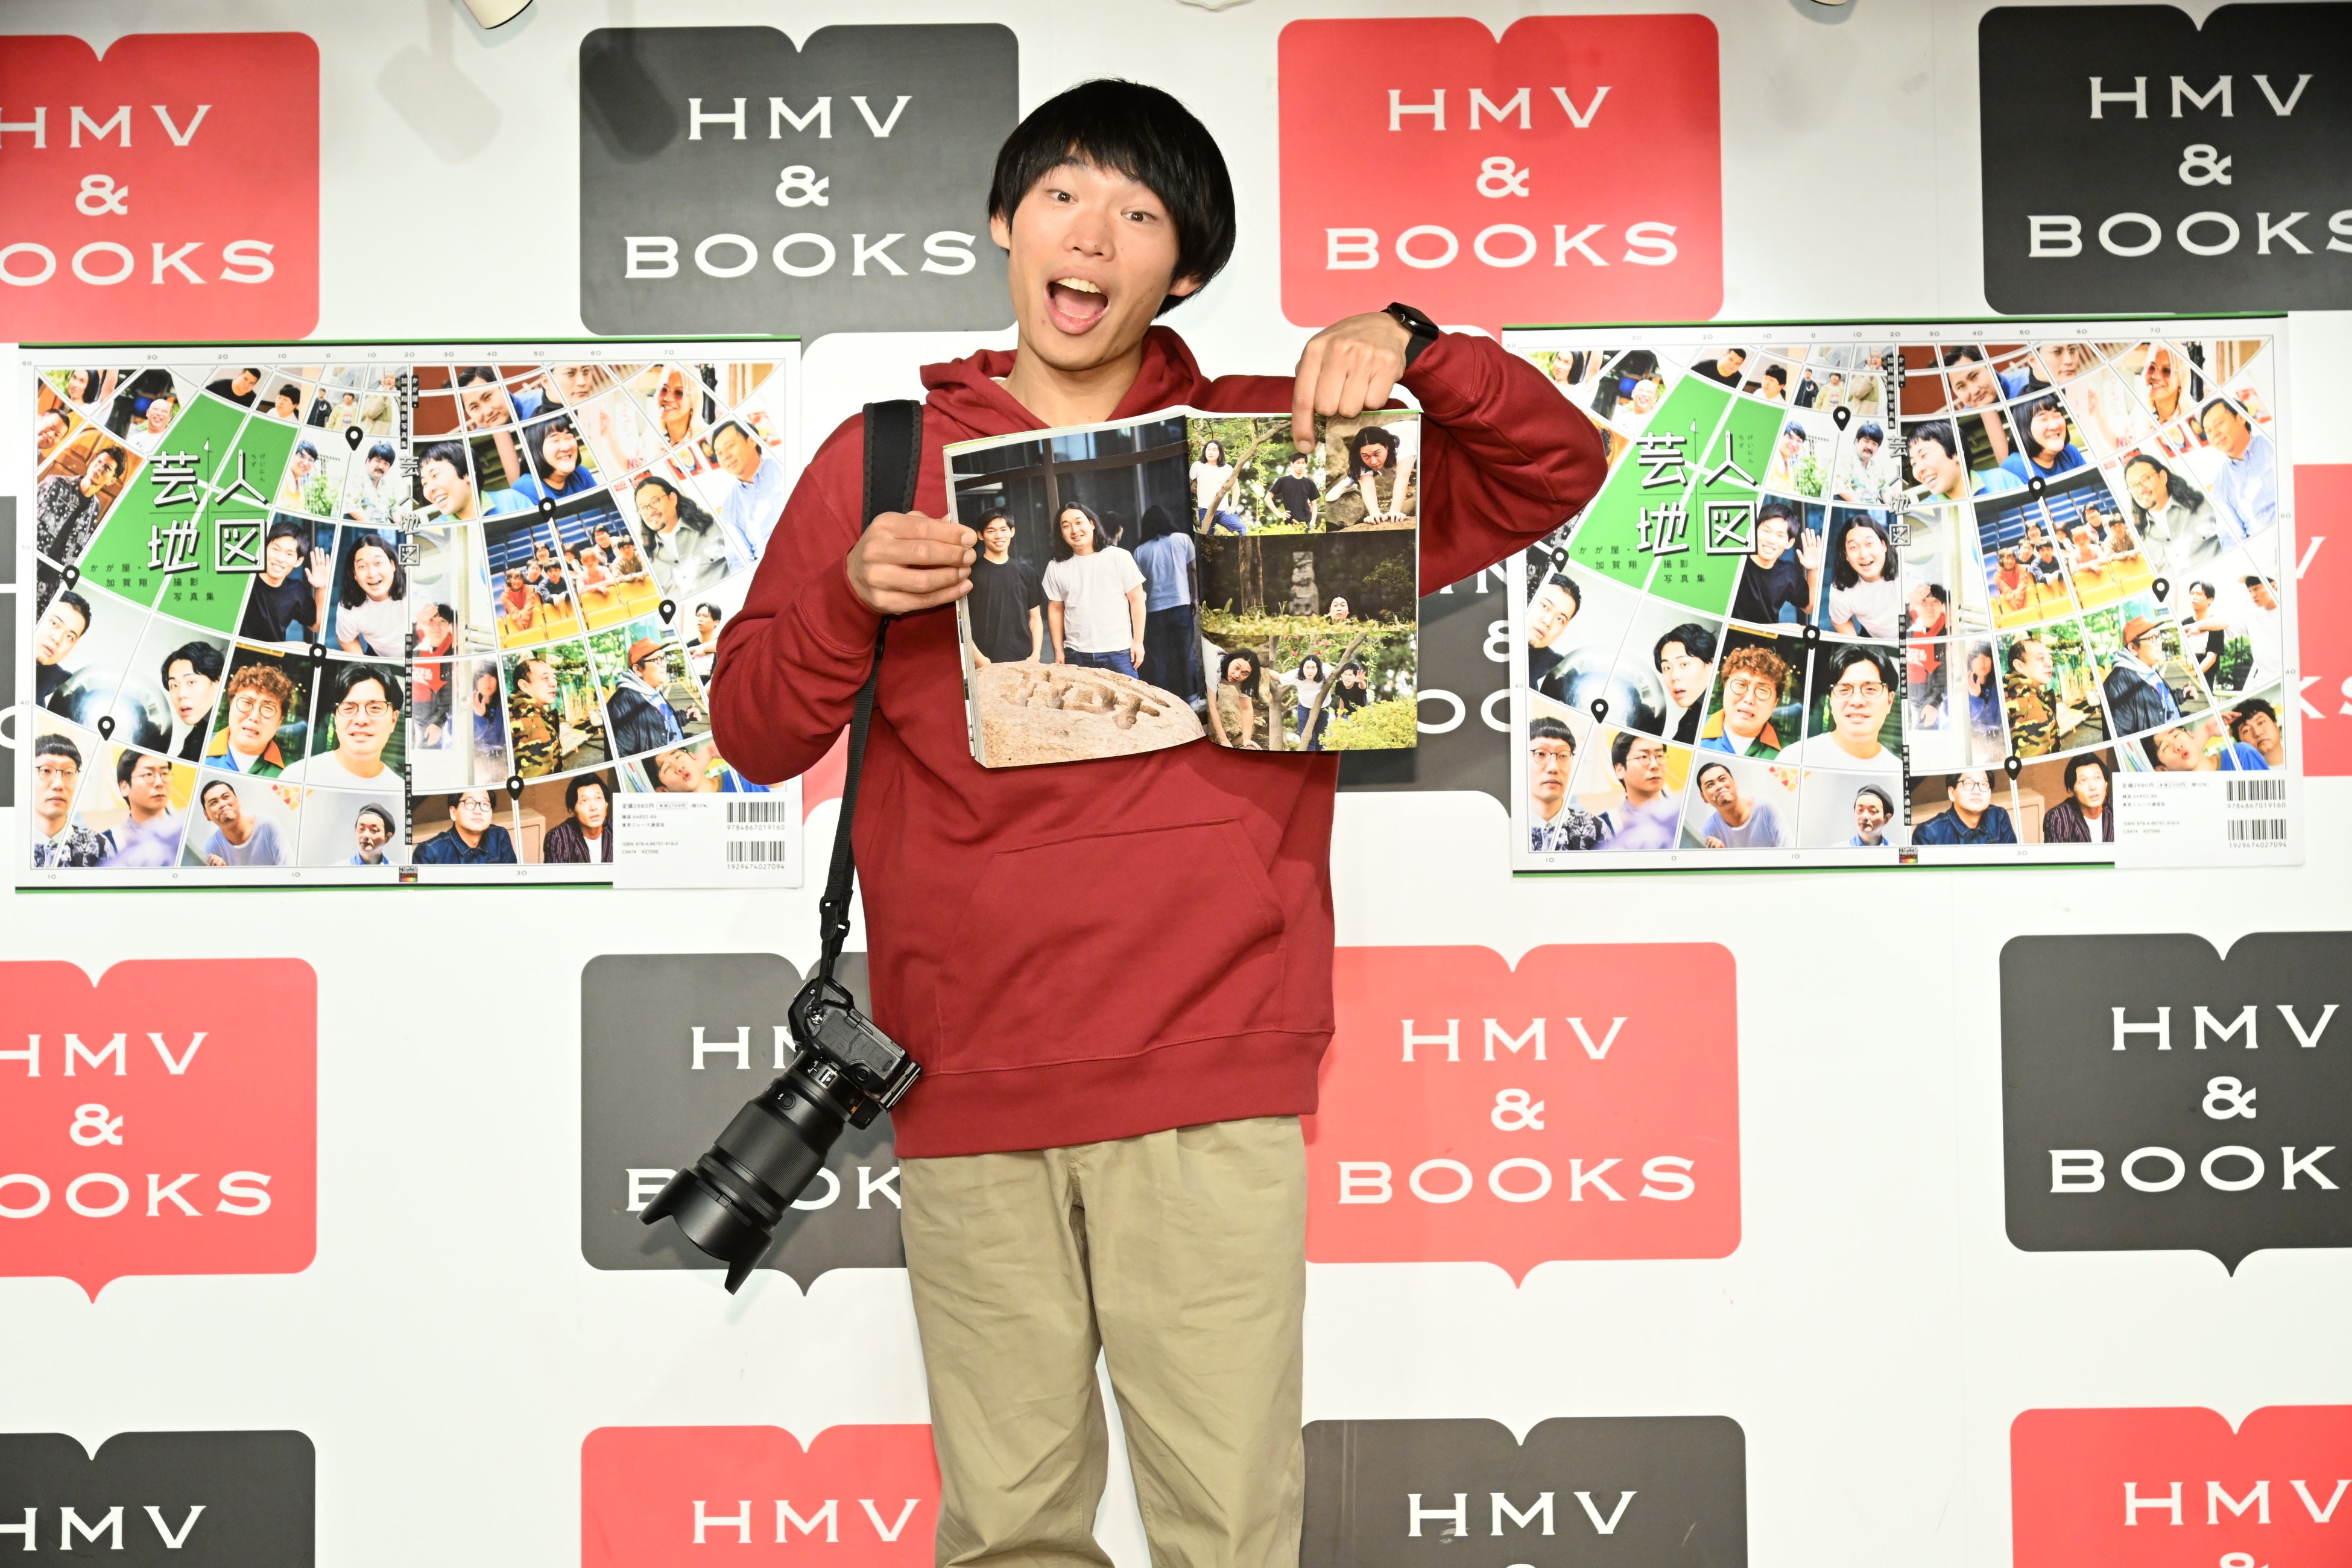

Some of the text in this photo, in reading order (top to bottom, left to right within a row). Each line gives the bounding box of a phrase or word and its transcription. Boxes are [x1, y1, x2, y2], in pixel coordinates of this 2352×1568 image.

[689, 96, 912, 139] HMV
[1388, 87, 1610, 130] HMV
[2090, 75, 2311, 118] HMV
[0, 105, 210, 148] HMV
[776, 166, 829, 207] &
[1477, 157, 1529, 198] &
[2179, 144, 2231, 186] &
[76, 175, 128, 215] &
[0, 240, 274, 286] OOKS
[625, 231, 976, 277] BOOKS
[1326, 222, 1677, 269] BOOKS
[147, 449, 268, 507] 芸人
[1634, 430, 1757, 489] 芸人
[398, 456, 420, 565] 芸人地図
[1888, 435, 1911, 546] 芸人地図
[147, 519, 267, 575] 地図
[1636, 500, 1759, 557] 地図
[106, 577, 198, 587] 加賀翔 撮影
[1595, 559, 1689, 569] 加賀翔 撮影
[1664, 574, 1706, 583] 写真集
[174, 592, 215, 601] 写真集
[1903, 747, 1911, 824] 東京ニュース通信社
[1402, 1017, 1627, 1061] HMV
[2112, 1005, 2339, 1050] HMV
[0, 1032, 207, 1076] HMV
[1491, 1089, 1544, 1131] &
[2202, 1076, 2256, 1119] &
[70, 1104, 122, 1146] &
[625, 1166, 901, 1212] BOK
[1338, 1156, 1694, 1203] BOOKS
[2049, 1146, 2339, 1192] BOOK
[0, 1171, 271, 1218] OOKS
[693, 1499, 920, 1543] HMV
[1408, 1491, 1637, 1536] HMV
[2124, 1480, 2351, 1525] HMV
[0, 1506, 206, 1551] HMV
